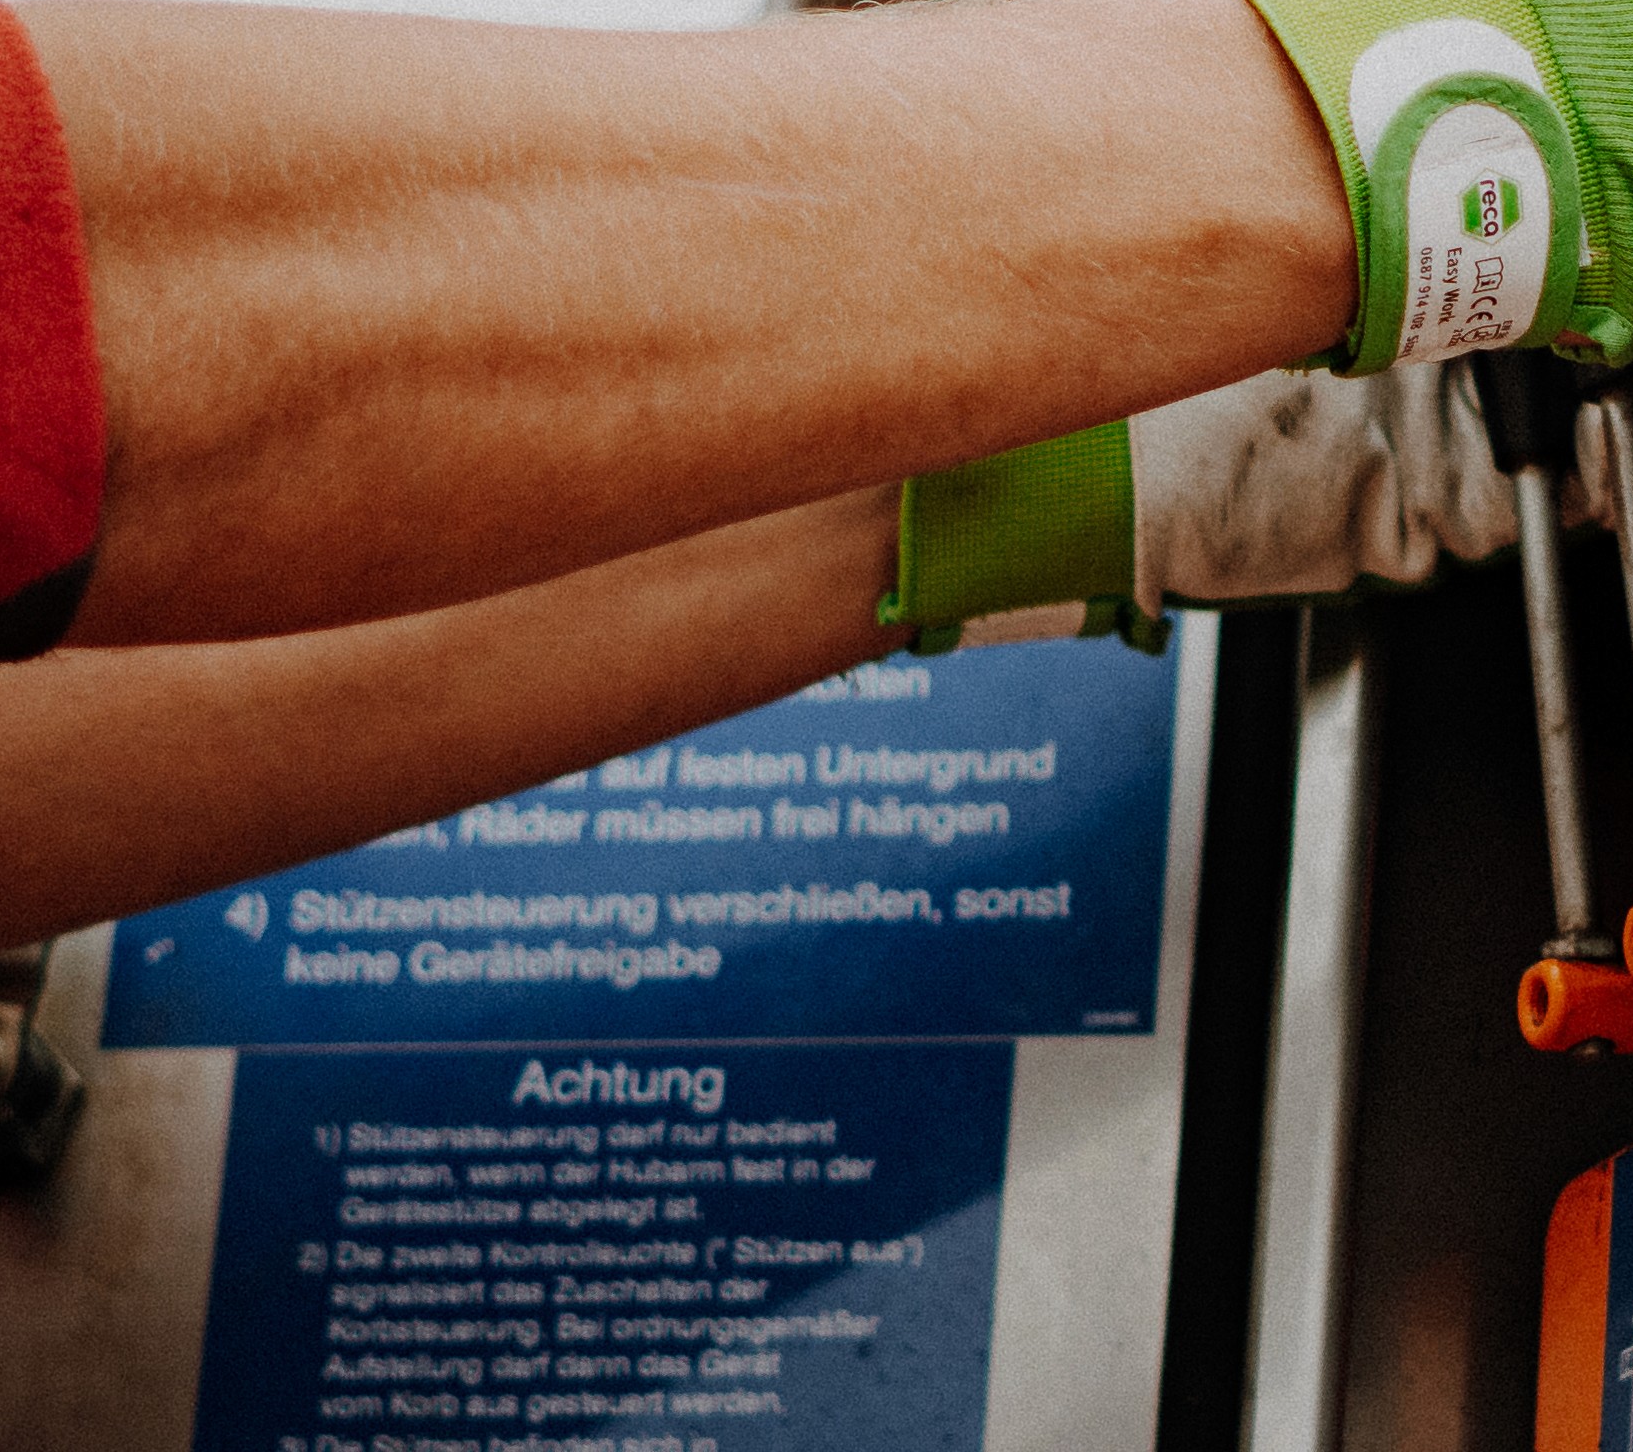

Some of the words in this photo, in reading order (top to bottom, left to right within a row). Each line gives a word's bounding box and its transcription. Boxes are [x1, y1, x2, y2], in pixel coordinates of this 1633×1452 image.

[1479, 179, 1499, 238] reca
[1420, 247, 1433, 281] 0687
[1442, 247, 1462, 285] Easy
[1416, 285, 1431, 309] 914
[1438, 288, 1460, 326] Work
[600, 748, 673, 790] auf
[677, 746, 806, 789] festen
[815, 741, 1057, 791] Untergrund
[457, 803, 589, 845] Räder
[593, 799, 764, 842] müssen
[770, 797, 841, 838] frei
[846, 797, 1013, 844] hängen
[225, 892, 268, 938] 4)
[287, 885, 659, 936] Stützensteuerung
[667, 881, 944, 930] verschließen,
[952, 881, 1073, 922] sonst
[282, 944, 401, 987] keine
[406, 939, 724, 991] Gerätefreigabe
[511, 1059, 726, 1113] Achtung
[346, 1122, 600, 1156] Stützensteuerung
[605, 1119, 665, 1149] darf
[670, 1123, 719, 1148] nur
[724, 1118, 838, 1146] bedient
[467, 1162, 547, 1187] wenn
[552, 1160, 601, 1187] der
[607, 1158, 727, 1185] Hubarm
[731, 1155, 786, 1184] fest
[790, 1157, 821, 1183] in
[825, 1155, 875, 1183] der
[527, 1196, 658, 1229] abgelegt
[334, 1240, 385, 1271] Die
[732, 1236, 845, 1266] Stützen
[492, 1280, 541, 1305] das
[552, 1275, 714, 1305] Zuschalten
[719, 1277, 769, 1302] der
[555, 1312, 605, 1342] Bei
[322, 1353, 484, 1386] Aufstellung
[490, 1352, 551, 1380] darf
[555, 1354, 633, 1380] dann
[637, 1352, 694, 1381] das
[697, 1346, 782, 1381] Gerät
[319, 1395, 385, 1420] vom
[388, 1392, 462, 1419] Korb
[465, 1394, 520, 1419] aus
[526, 1390, 669, 1424] gesteuert
